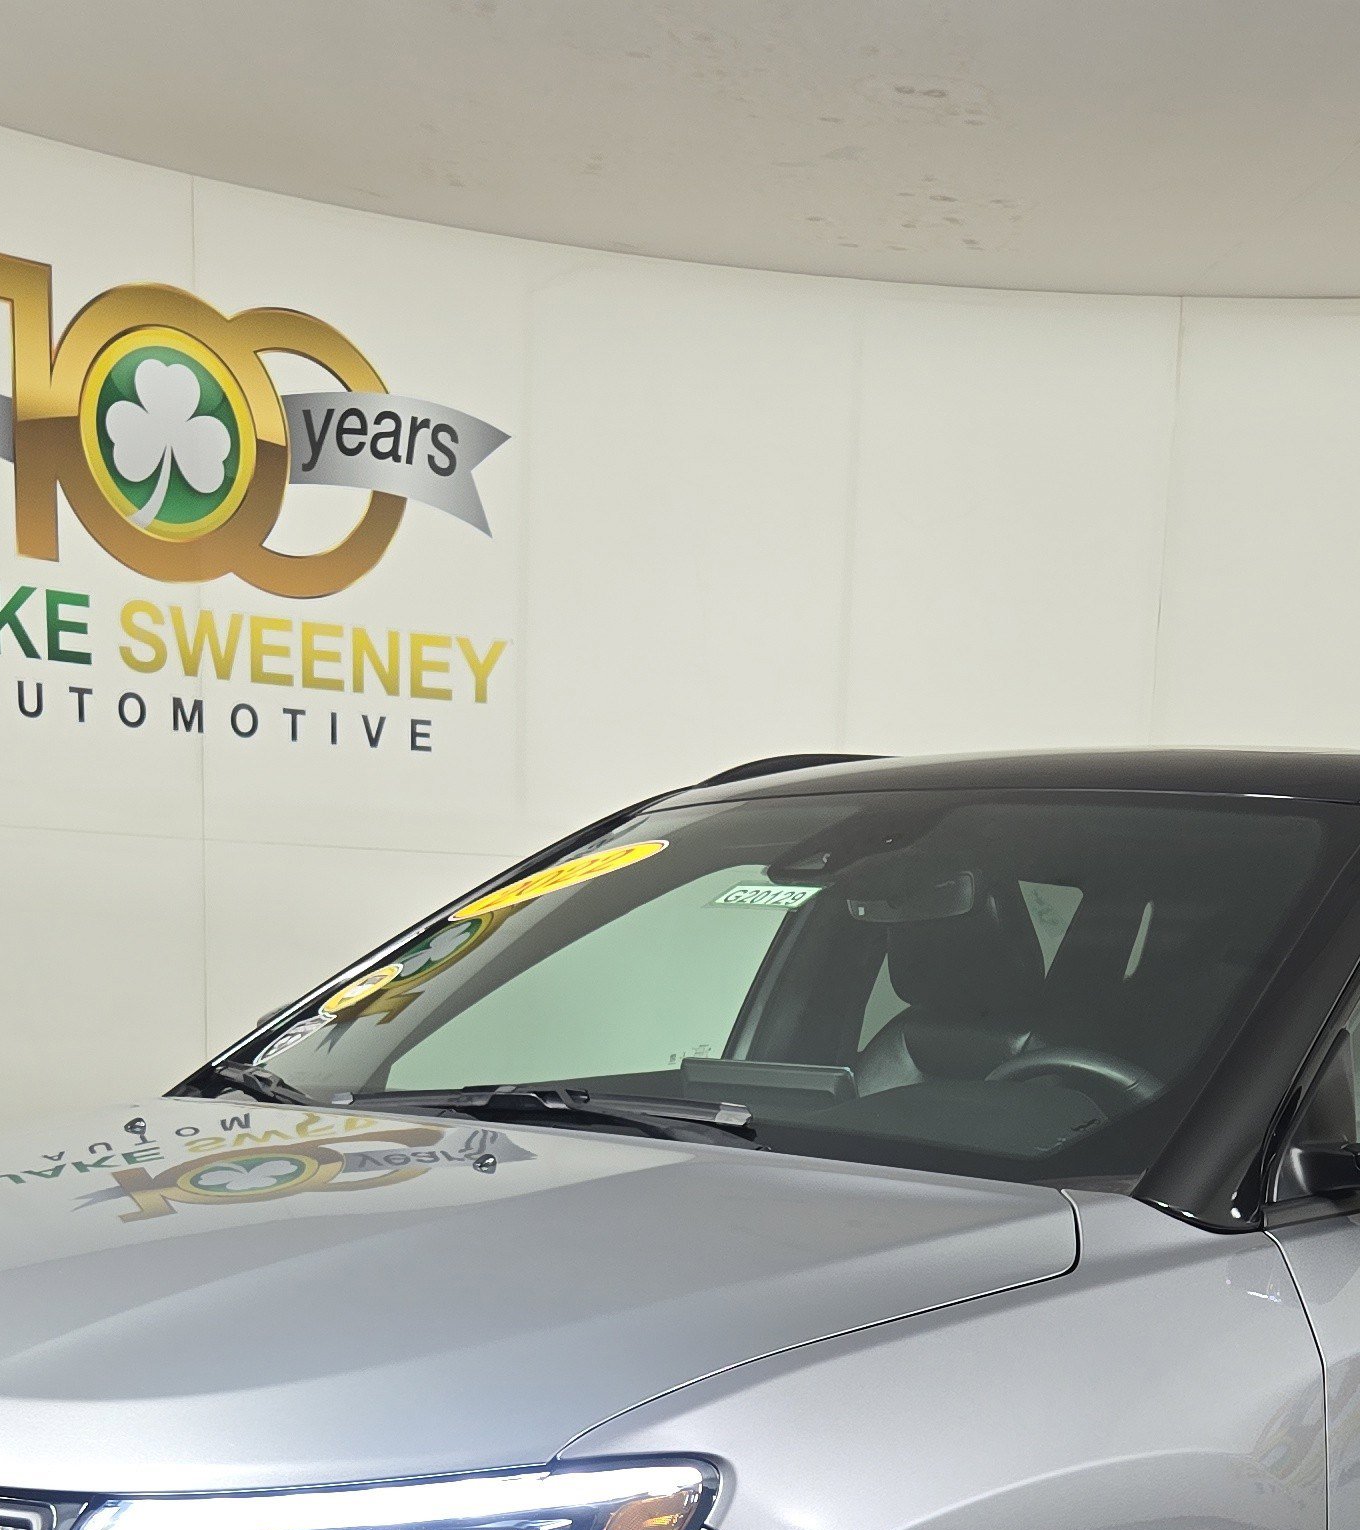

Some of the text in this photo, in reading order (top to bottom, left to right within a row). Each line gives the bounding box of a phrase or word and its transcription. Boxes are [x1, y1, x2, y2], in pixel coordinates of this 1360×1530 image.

[301, 405, 459, 477] years
[119, 600, 508, 703] SWEENEY
[723, 889, 806, 905] G20129
